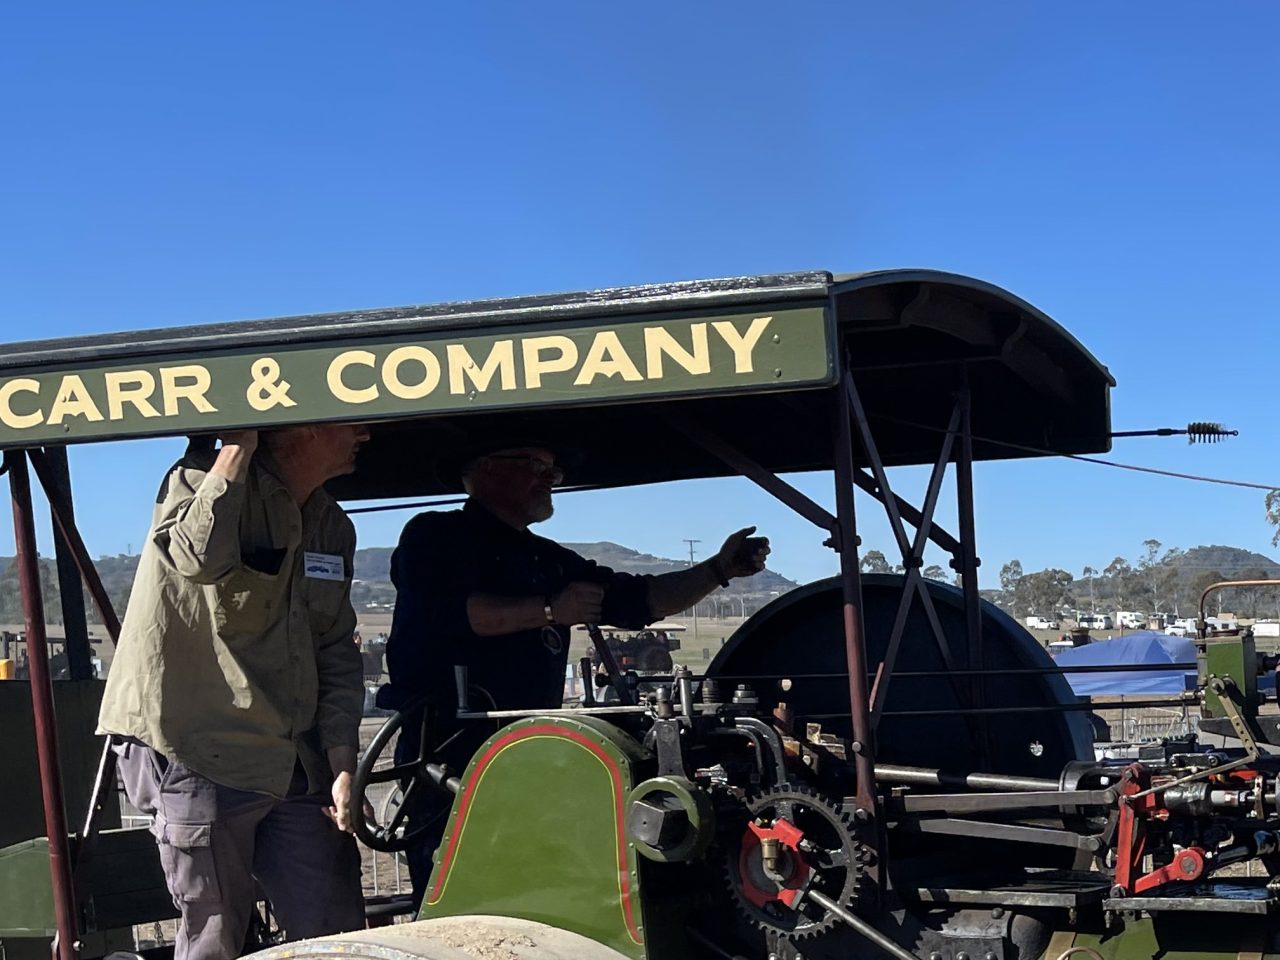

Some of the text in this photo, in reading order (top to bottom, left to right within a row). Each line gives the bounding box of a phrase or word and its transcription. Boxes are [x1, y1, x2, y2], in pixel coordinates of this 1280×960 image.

[0, 316, 773, 429] CARR & COMPANY
